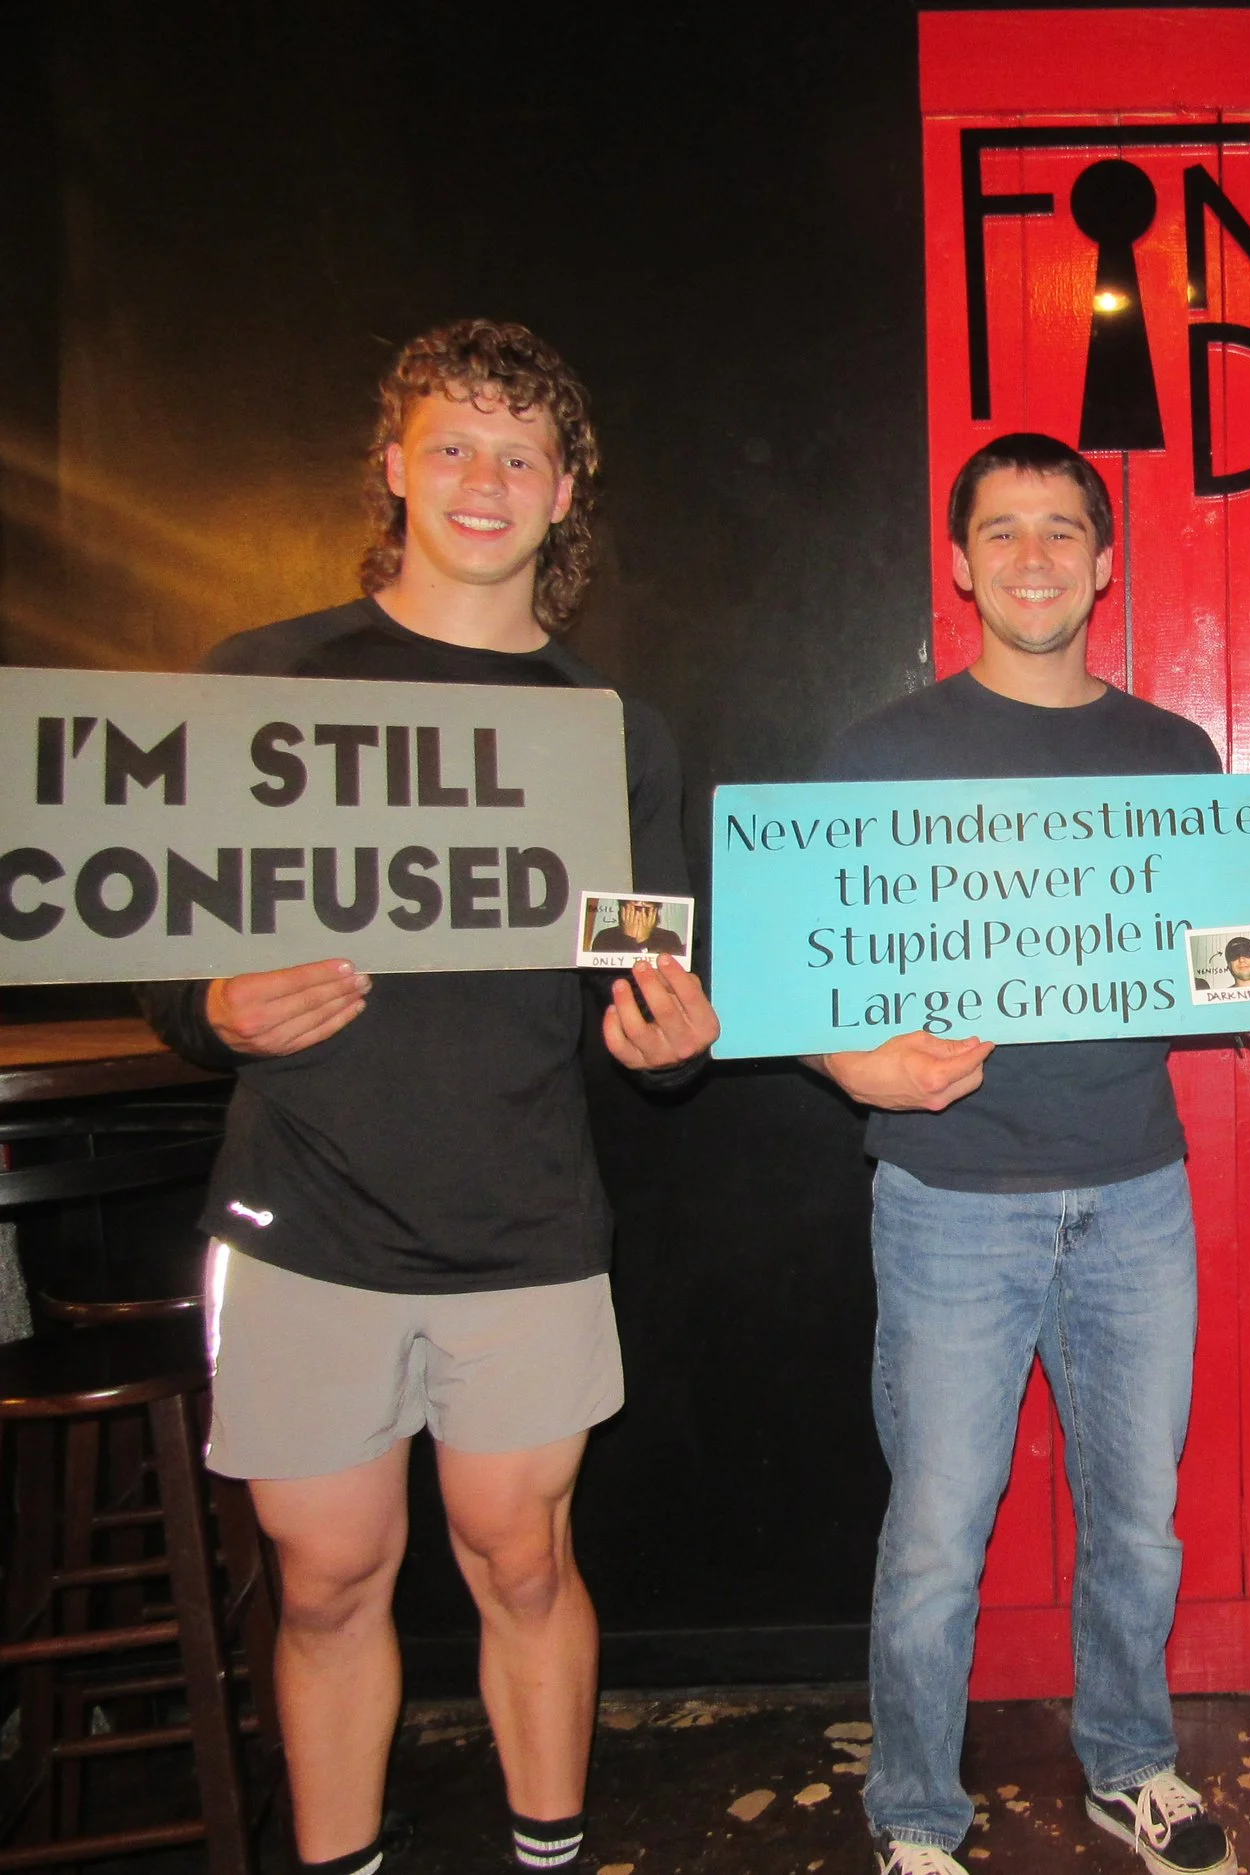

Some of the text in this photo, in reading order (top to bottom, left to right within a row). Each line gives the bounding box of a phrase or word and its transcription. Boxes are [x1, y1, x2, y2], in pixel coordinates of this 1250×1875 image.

[36, 716, 525, 808] I'M STILL
[727, 813, 878, 852] Never
[0, 845, 570, 942] CONFUSED
[834, 853, 1163, 907] the Power of
[592, 956, 625, 967] ONLY
[807, 919, 971, 976] Stupid
[983, 912, 1142, 967] People
[831, 979, 1175, 1034] Large Groups
